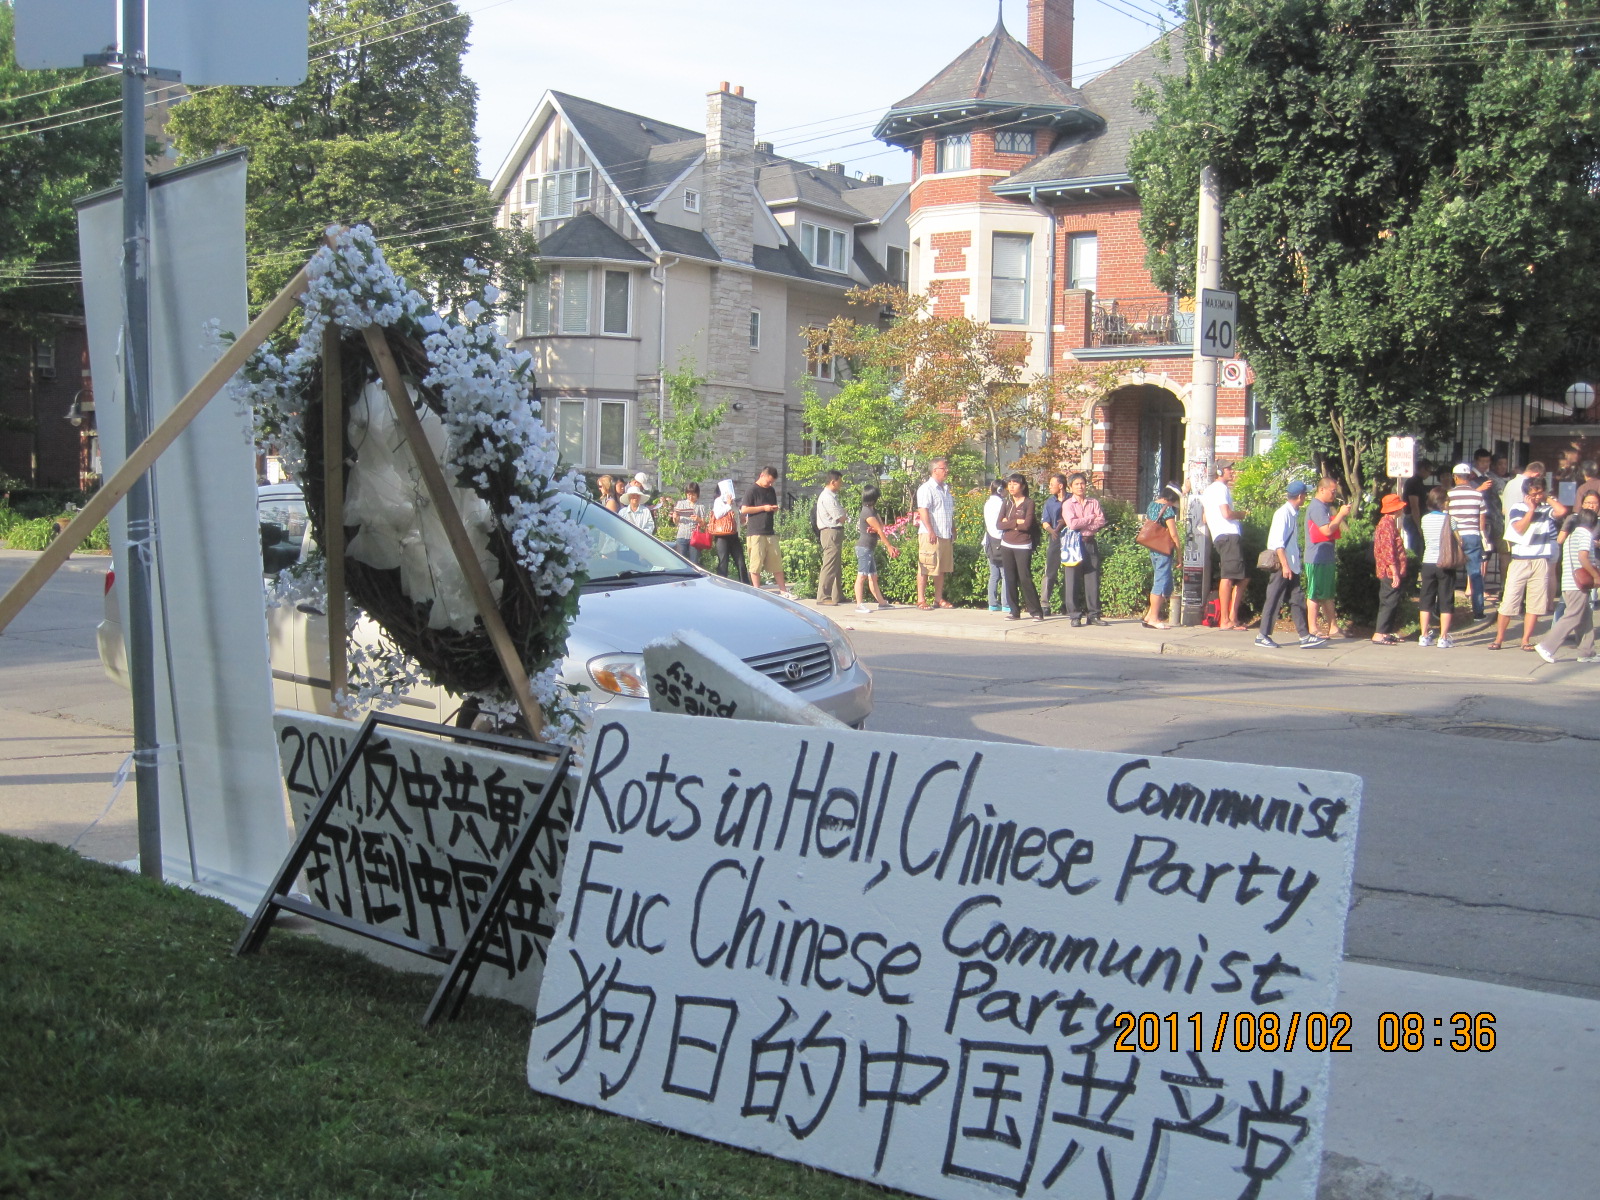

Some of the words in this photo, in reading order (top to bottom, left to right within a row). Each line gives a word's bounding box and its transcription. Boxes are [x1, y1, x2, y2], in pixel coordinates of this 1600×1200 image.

[1204, 320, 1232, 349] 40
[1205, 298, 1233, 310] MAXIMUM
[1389, 451, 1411, 459] PARKING
[574, 721, 704, 841] Rots
[714, 768, 773, 851] in
[775, 740, 897, 894] Hell,
[900, 751, 1100, 895] Chinese
[1107, 758, 1350, 842] Communist
[568, 840, 671, 956] Fuc
[690, 855, 922, 1004] Chinese
[942, 894, 1302, 1006] Communist
[1114, 834, 1320, 934] Party
[944, 960, 1131, 1052] Party
[534, 949, 1311, 1200] 狗日的中国共产党
